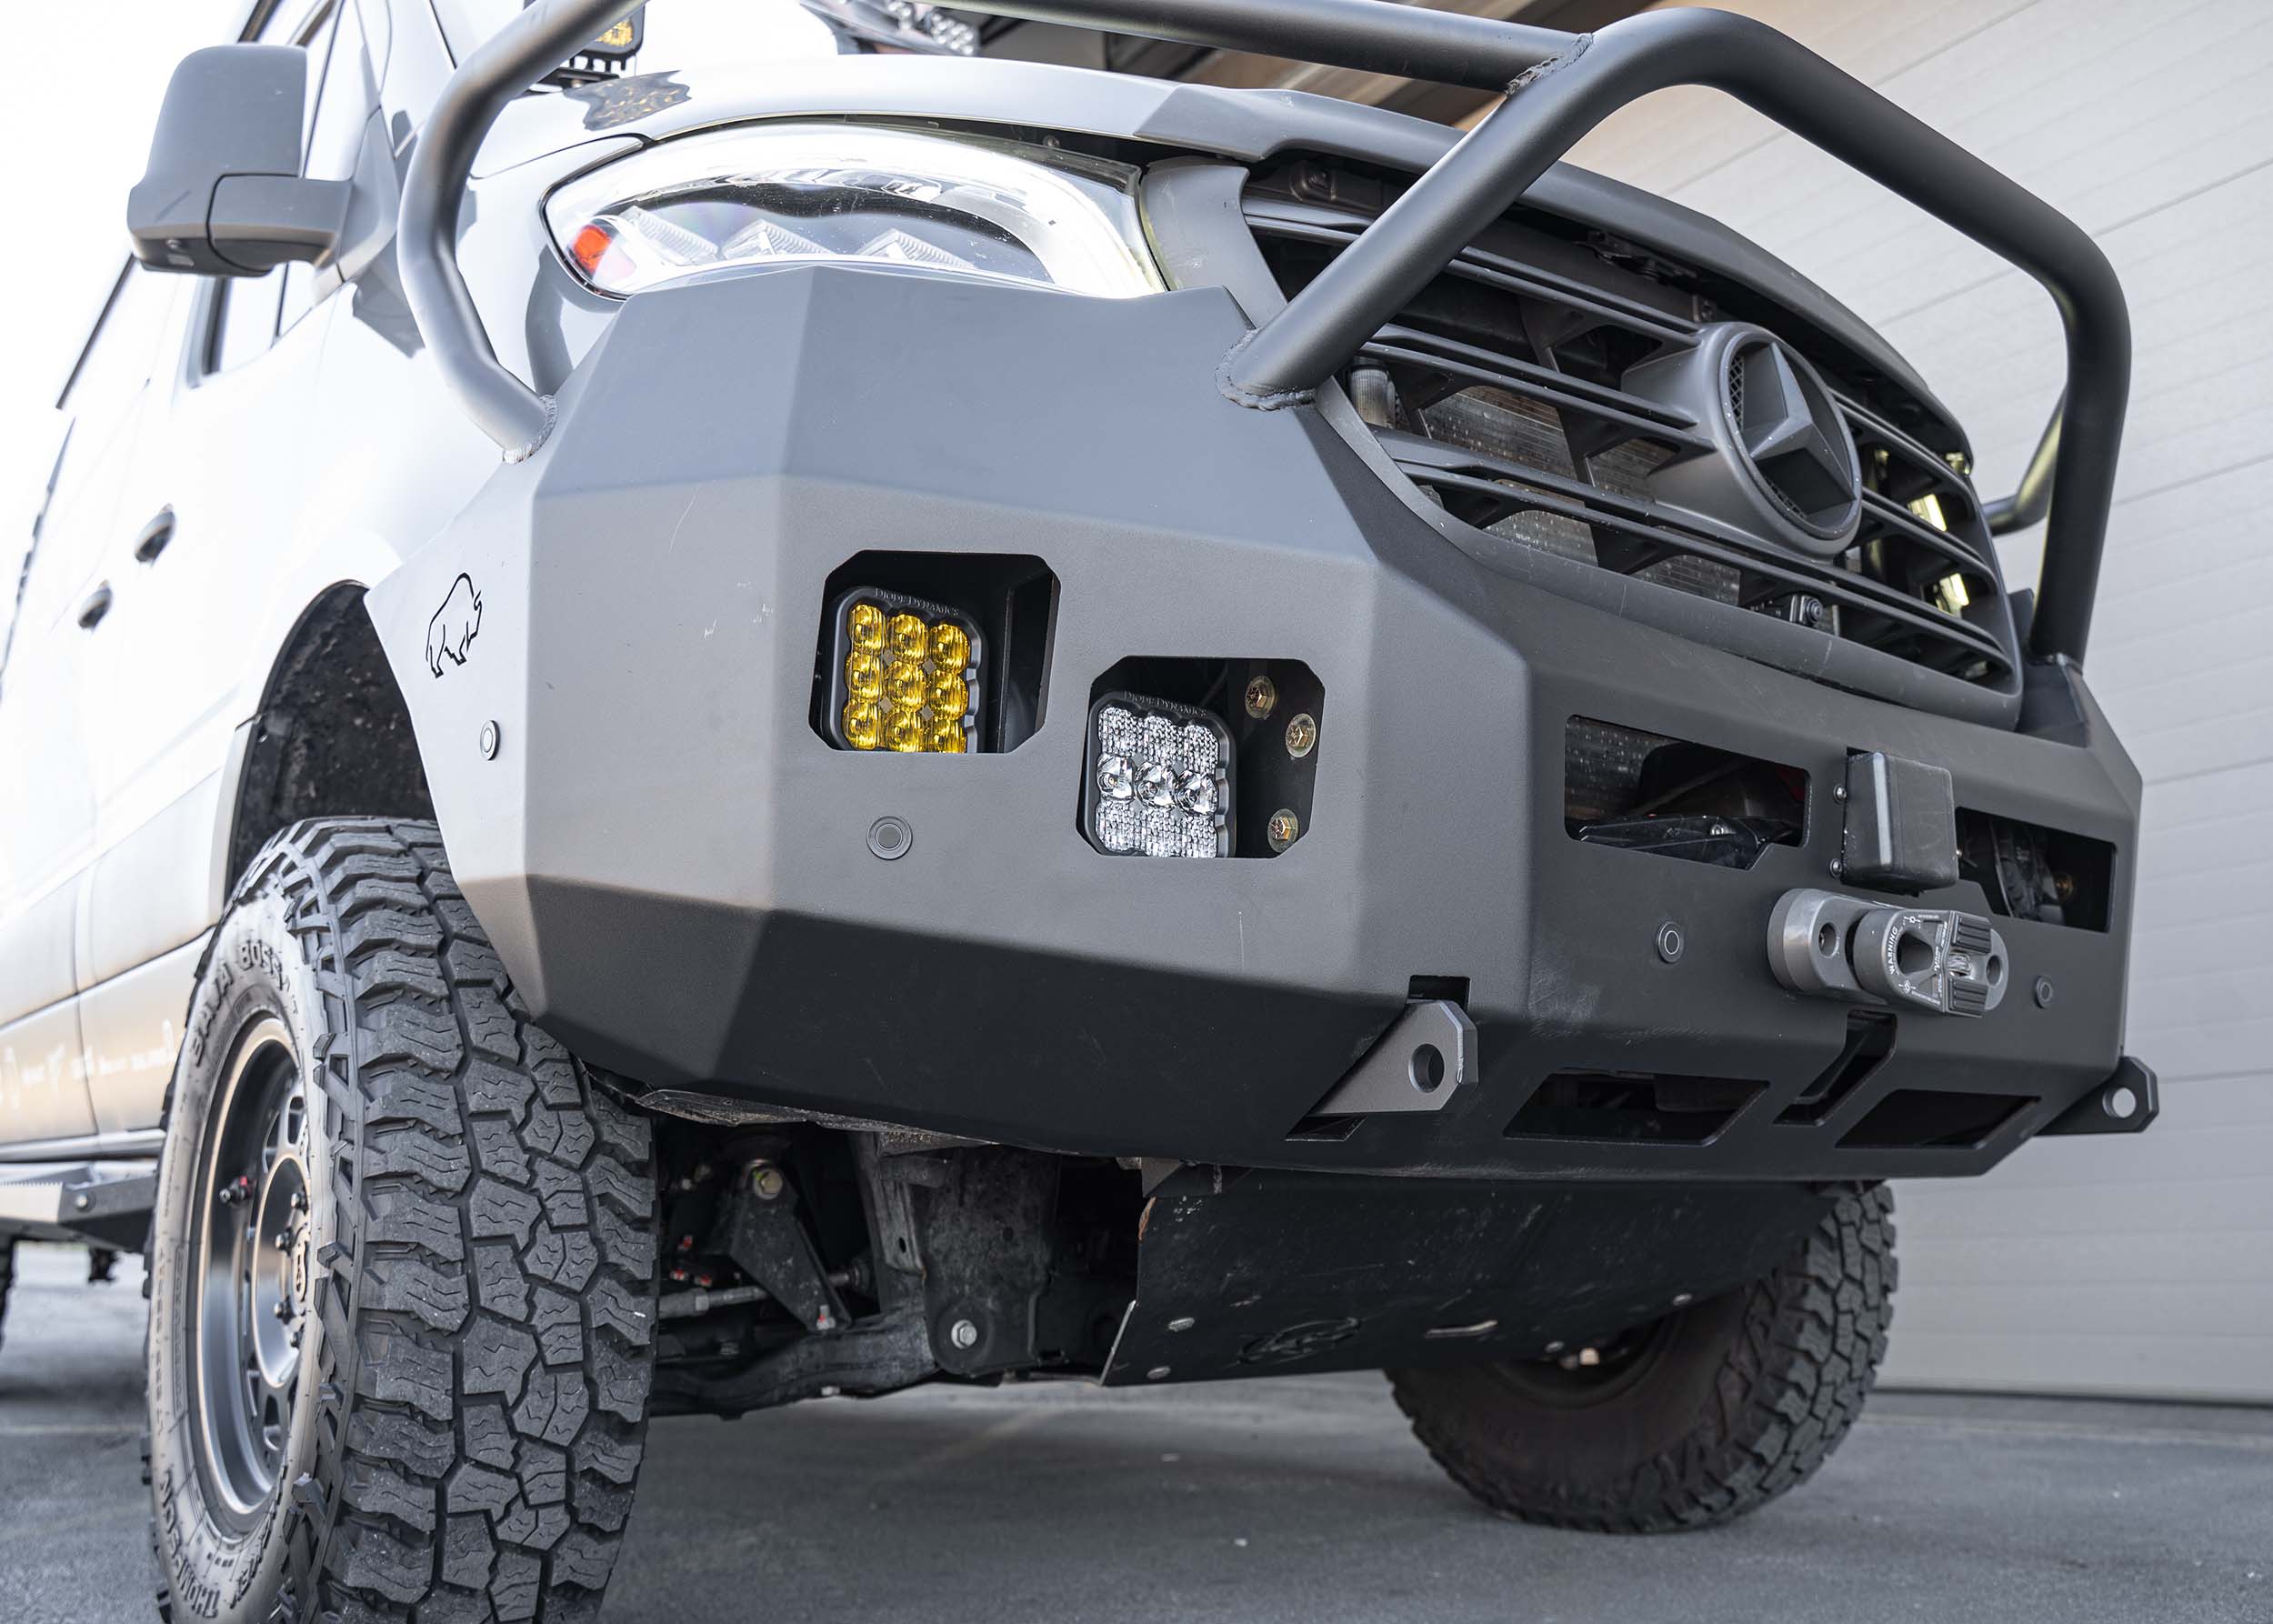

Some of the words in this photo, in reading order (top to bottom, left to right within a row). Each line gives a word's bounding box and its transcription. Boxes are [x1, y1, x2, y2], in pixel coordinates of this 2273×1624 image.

[1887, 926, 1898, 975] WARNING
[189, 961, 235, 1068] BAJA
[236, 939, 283, 991] BOSS
